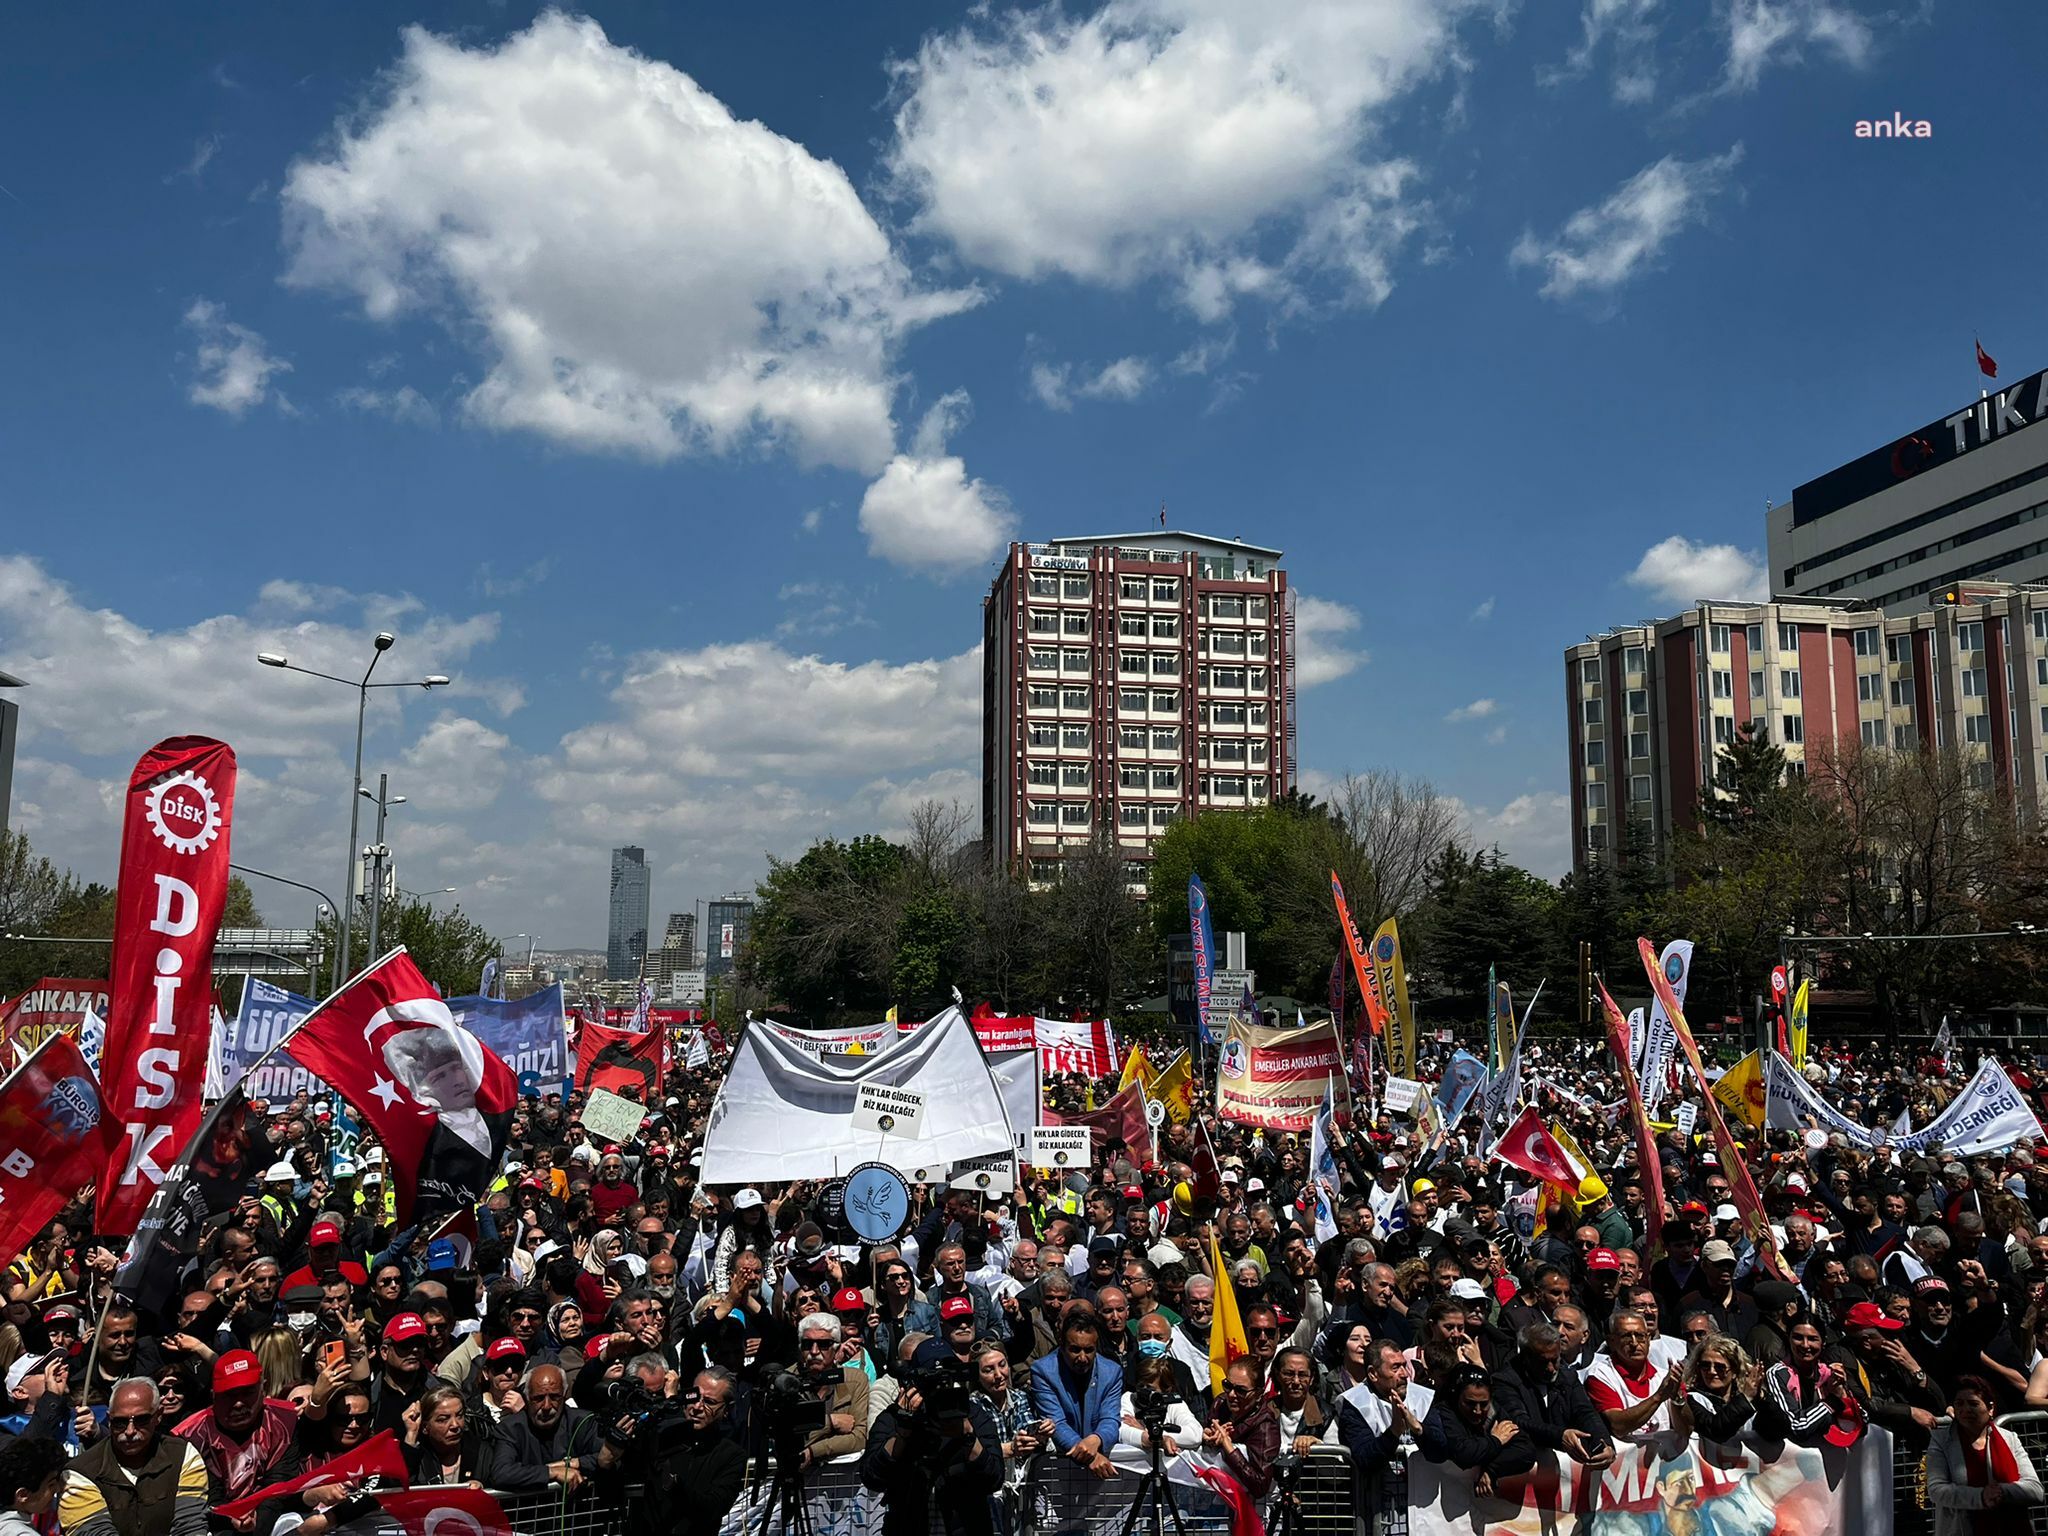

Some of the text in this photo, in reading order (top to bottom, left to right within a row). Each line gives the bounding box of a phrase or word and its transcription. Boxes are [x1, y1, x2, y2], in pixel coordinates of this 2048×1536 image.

[163, 796, 205, 825] DİSK
[21, 990, 92, 1014] ENKAZ
[119, 873, 199, 1186] DİSK
[1042, 1048, 1097, 1079] TKH
[1290, 1056, 1319, 1071] ANKARA
[56, 1077, 100, 1125] BÜRO-İŞ
[860, 1085, 923, 1107] KHK'LAR GİDECEK,
[862, 1098, 916, 1118] BİZ KALACAĞIZ
[1951, 1090, 2020, 1136] DERNEĞİ
[1034, 1128, 1088, 1139] KHK'LAR GİDECEK,
[1038, 1140, 1049, 1150] BİZ
[1049, 1140, 1084, 1150] KALACAĞIZ
[960, 1160, 1009, 1173] BİZ KALACAĞIZ
